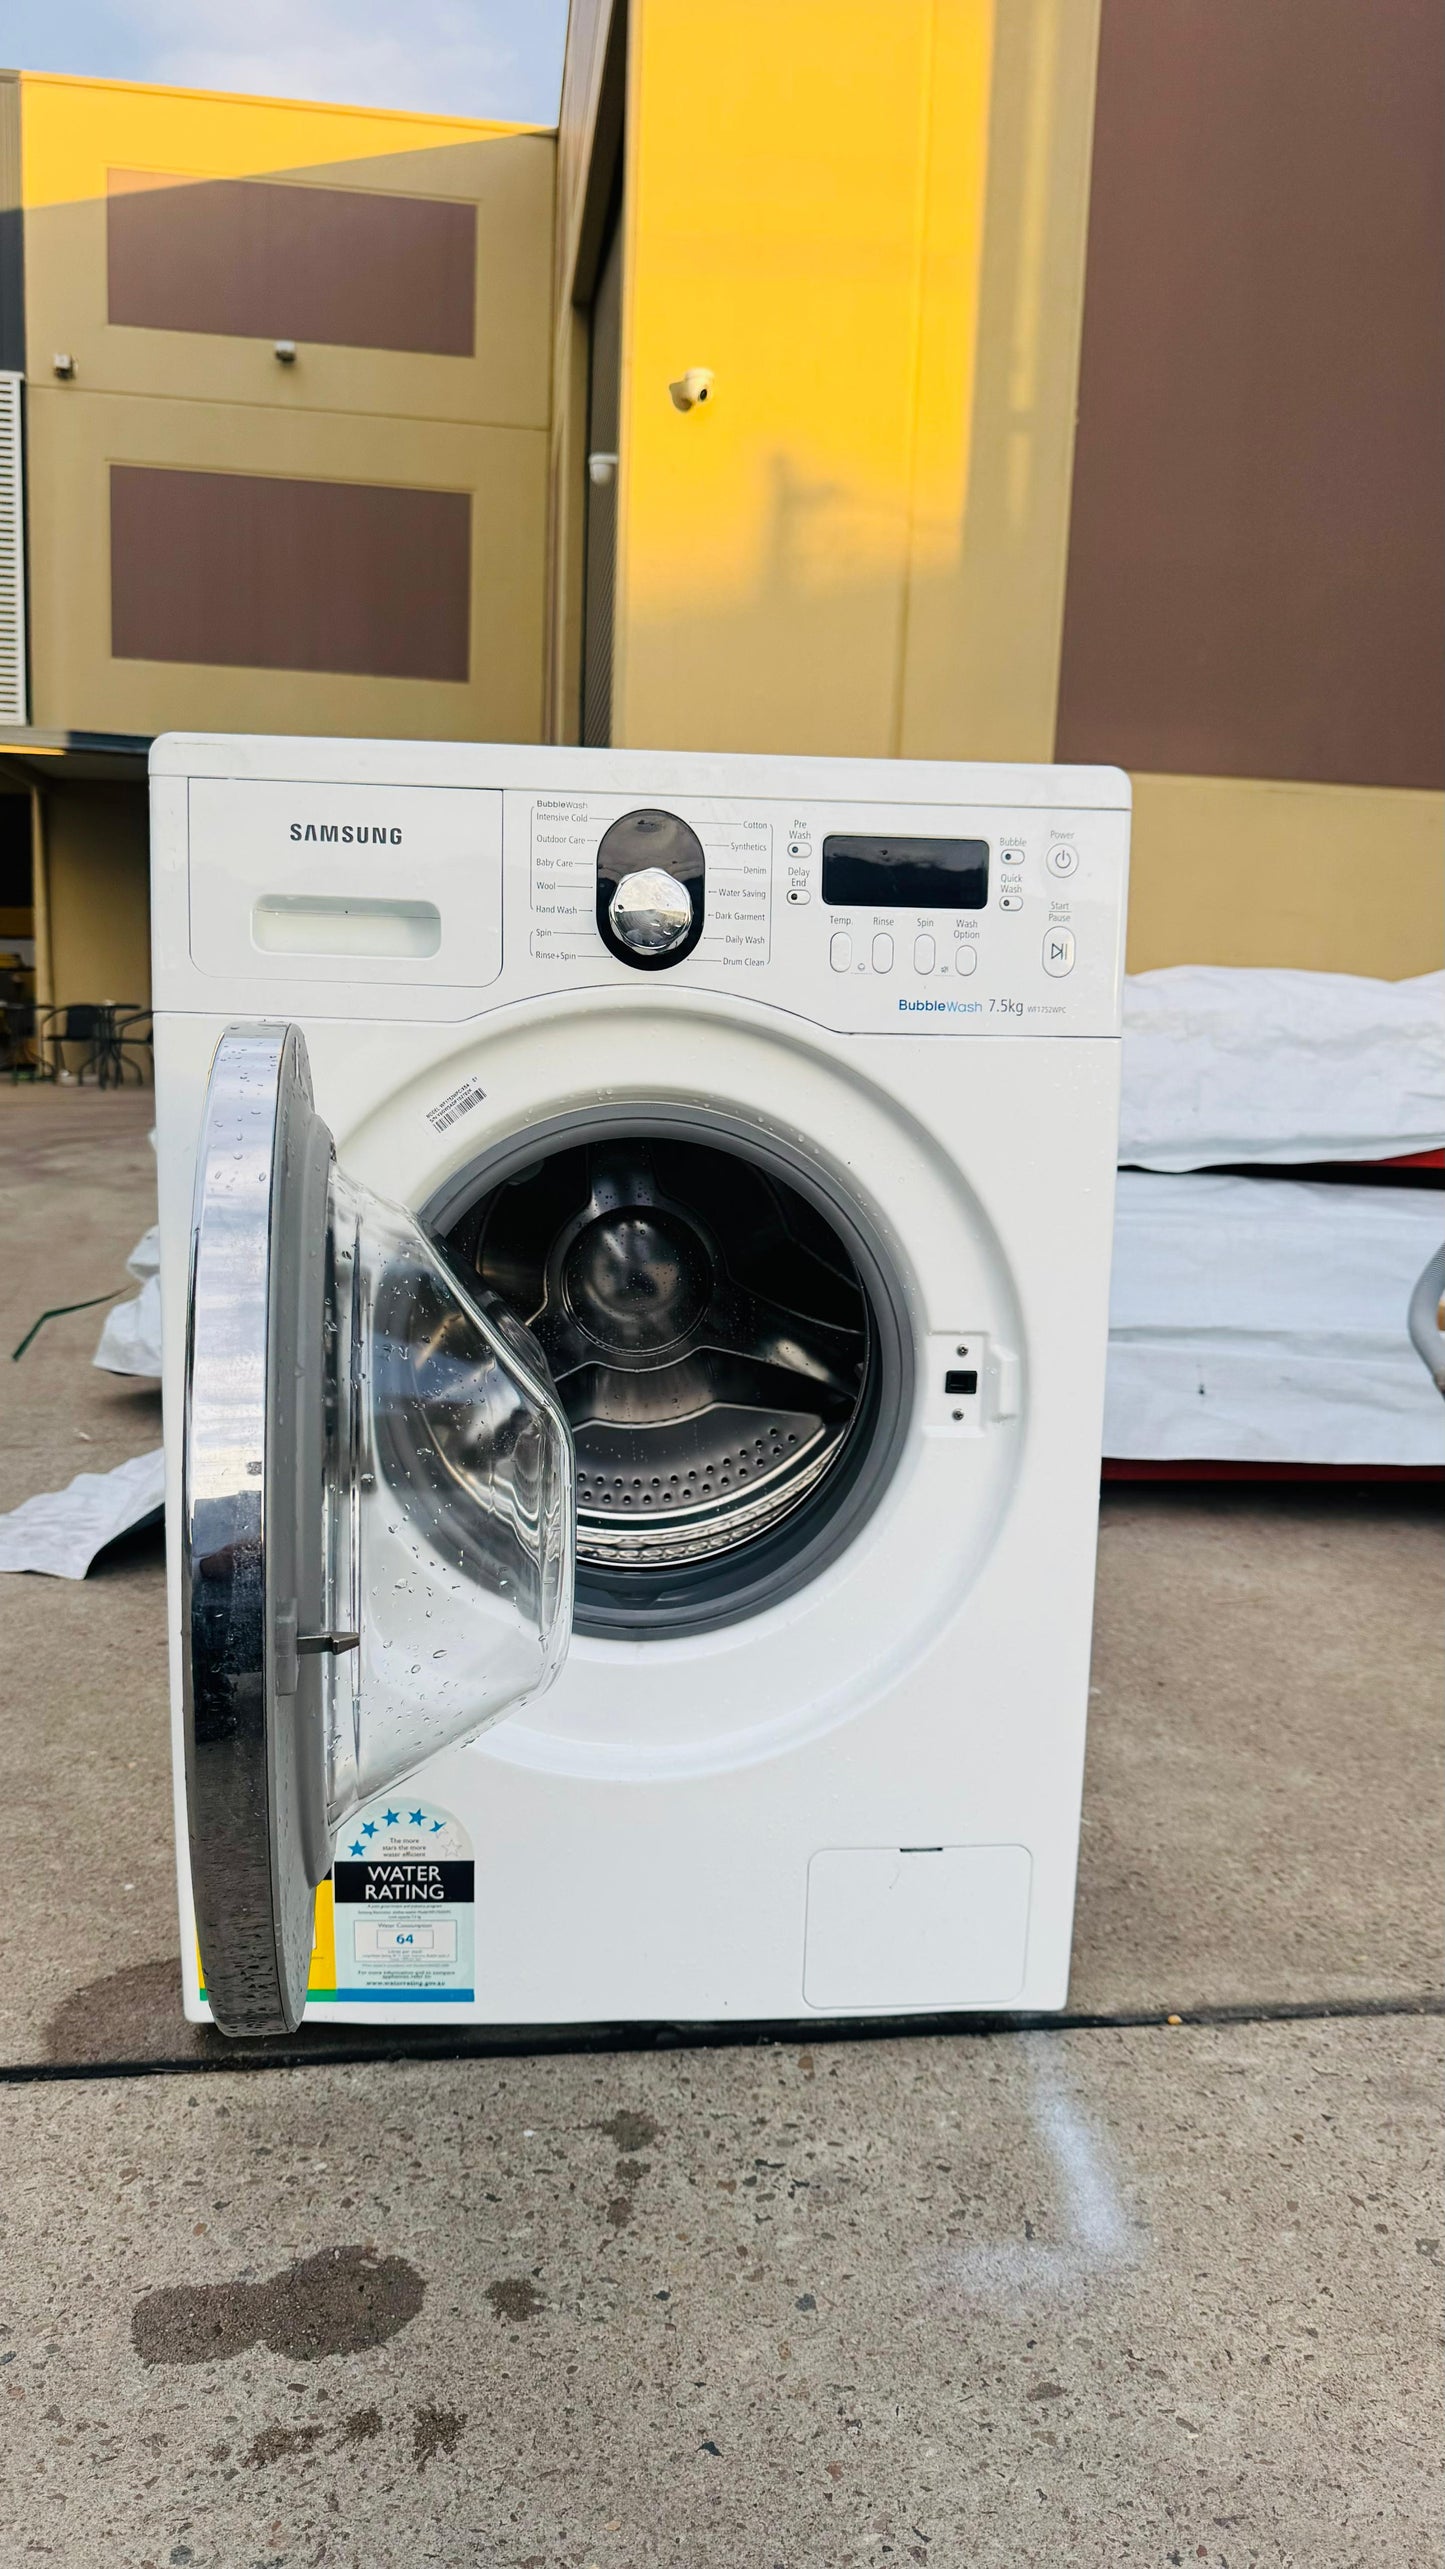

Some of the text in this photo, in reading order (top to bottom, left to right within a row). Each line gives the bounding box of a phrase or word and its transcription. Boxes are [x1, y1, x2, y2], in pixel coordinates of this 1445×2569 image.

[536, 800, 588, 809] BubbleWash
[536, 812, 588, 823] Intensive Cold
[743, 820, 768, 829] Cotton
[794, 819, 807, 829] Pre
[289, 823, 403, 846] SAMSUNG
[536, 834, 586, 844] Outdoor Care
[789, 830, 812, 839] Wash
[1050, 830, 1075, 839] Power
[730, 842, 767, 852] Synthetics
[1000, 837, 1027, 847] Bubble
[536, 858, 574, 868] Baby Care
[743, 866, 767, 875] Denim
[787, 867, 810, 878] Delay
[791, 878, 807, 887] End
[1000, 873, 1023, 883] Quick
[536, 882, 556, 890] Wool
[1000, 884, 1022, 893] Wash
[718, 888, 766, 900] Water Saving
[536, 905, 577, 915] Hand Wash
[1050, 901, 1069, 910] Start
[715, 911, 765, 921] Dark Garment
[830, 915, 853, 926] Temp.
[873, 916, 895, 926] Rinse
[1048, 913, 1071, 922] Pause
[917, 917, 934, 928] Spin
[956, 919, 978, 928] Wash
[536, 928, 552, 938] Spin
[953, 930, 980, 940] Option
[725, 935, 765, 945] Daily Wash
[535, 951, 577, 961] Rinse+Spin
[723, 957, 765, 967] Drum Clean
[898, 999, 983, 1013] BubbleWash
[988, 998, 1024, 1017] 7.5kg
[367, 1865, 442, 1882] WATER
[365, 1884, 445, 1900] RATING
[396, 1933, 414, 1945] 64
